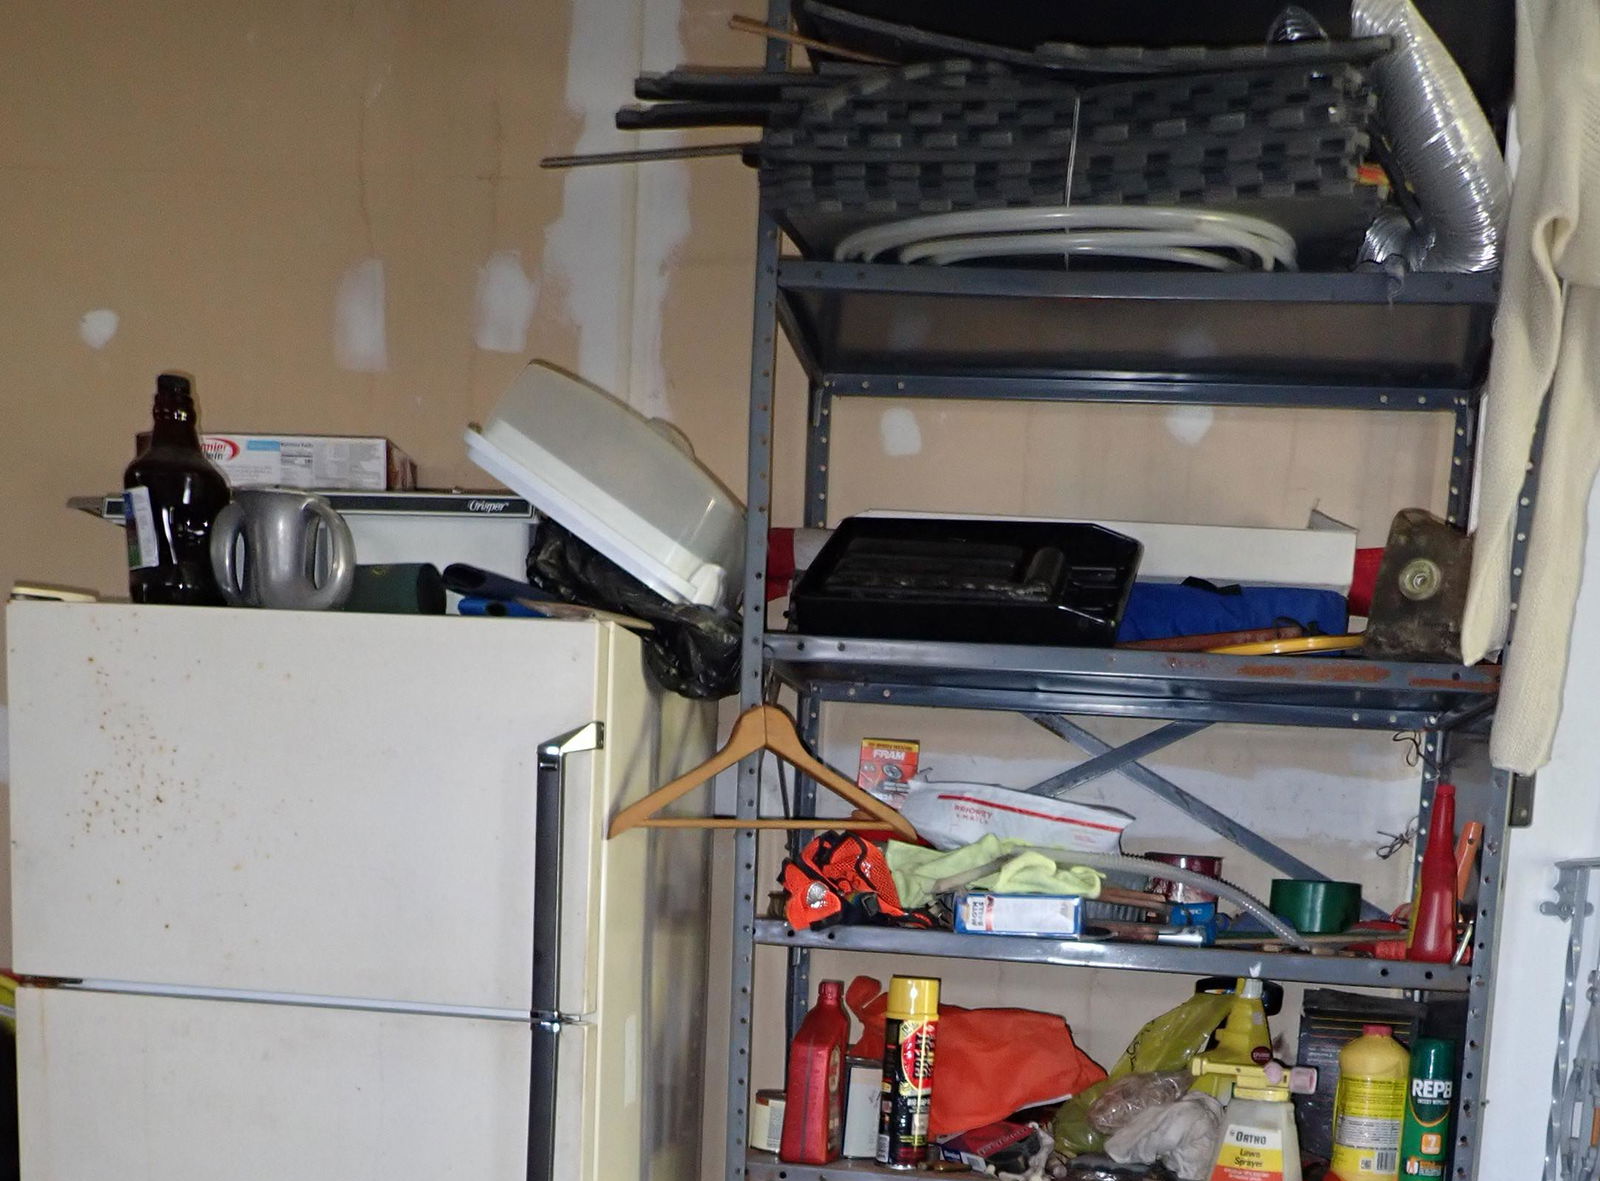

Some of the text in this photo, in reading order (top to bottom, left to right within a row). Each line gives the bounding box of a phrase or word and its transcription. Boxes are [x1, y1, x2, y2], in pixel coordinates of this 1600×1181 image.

[873, 749, 905, 761] FRAM
[1235, 1130, 1267, 1146] ORTHO
[1239, 1148, 1261, 1158] Lawn
[1234, 1157, 1263, 1168] Sprayer
